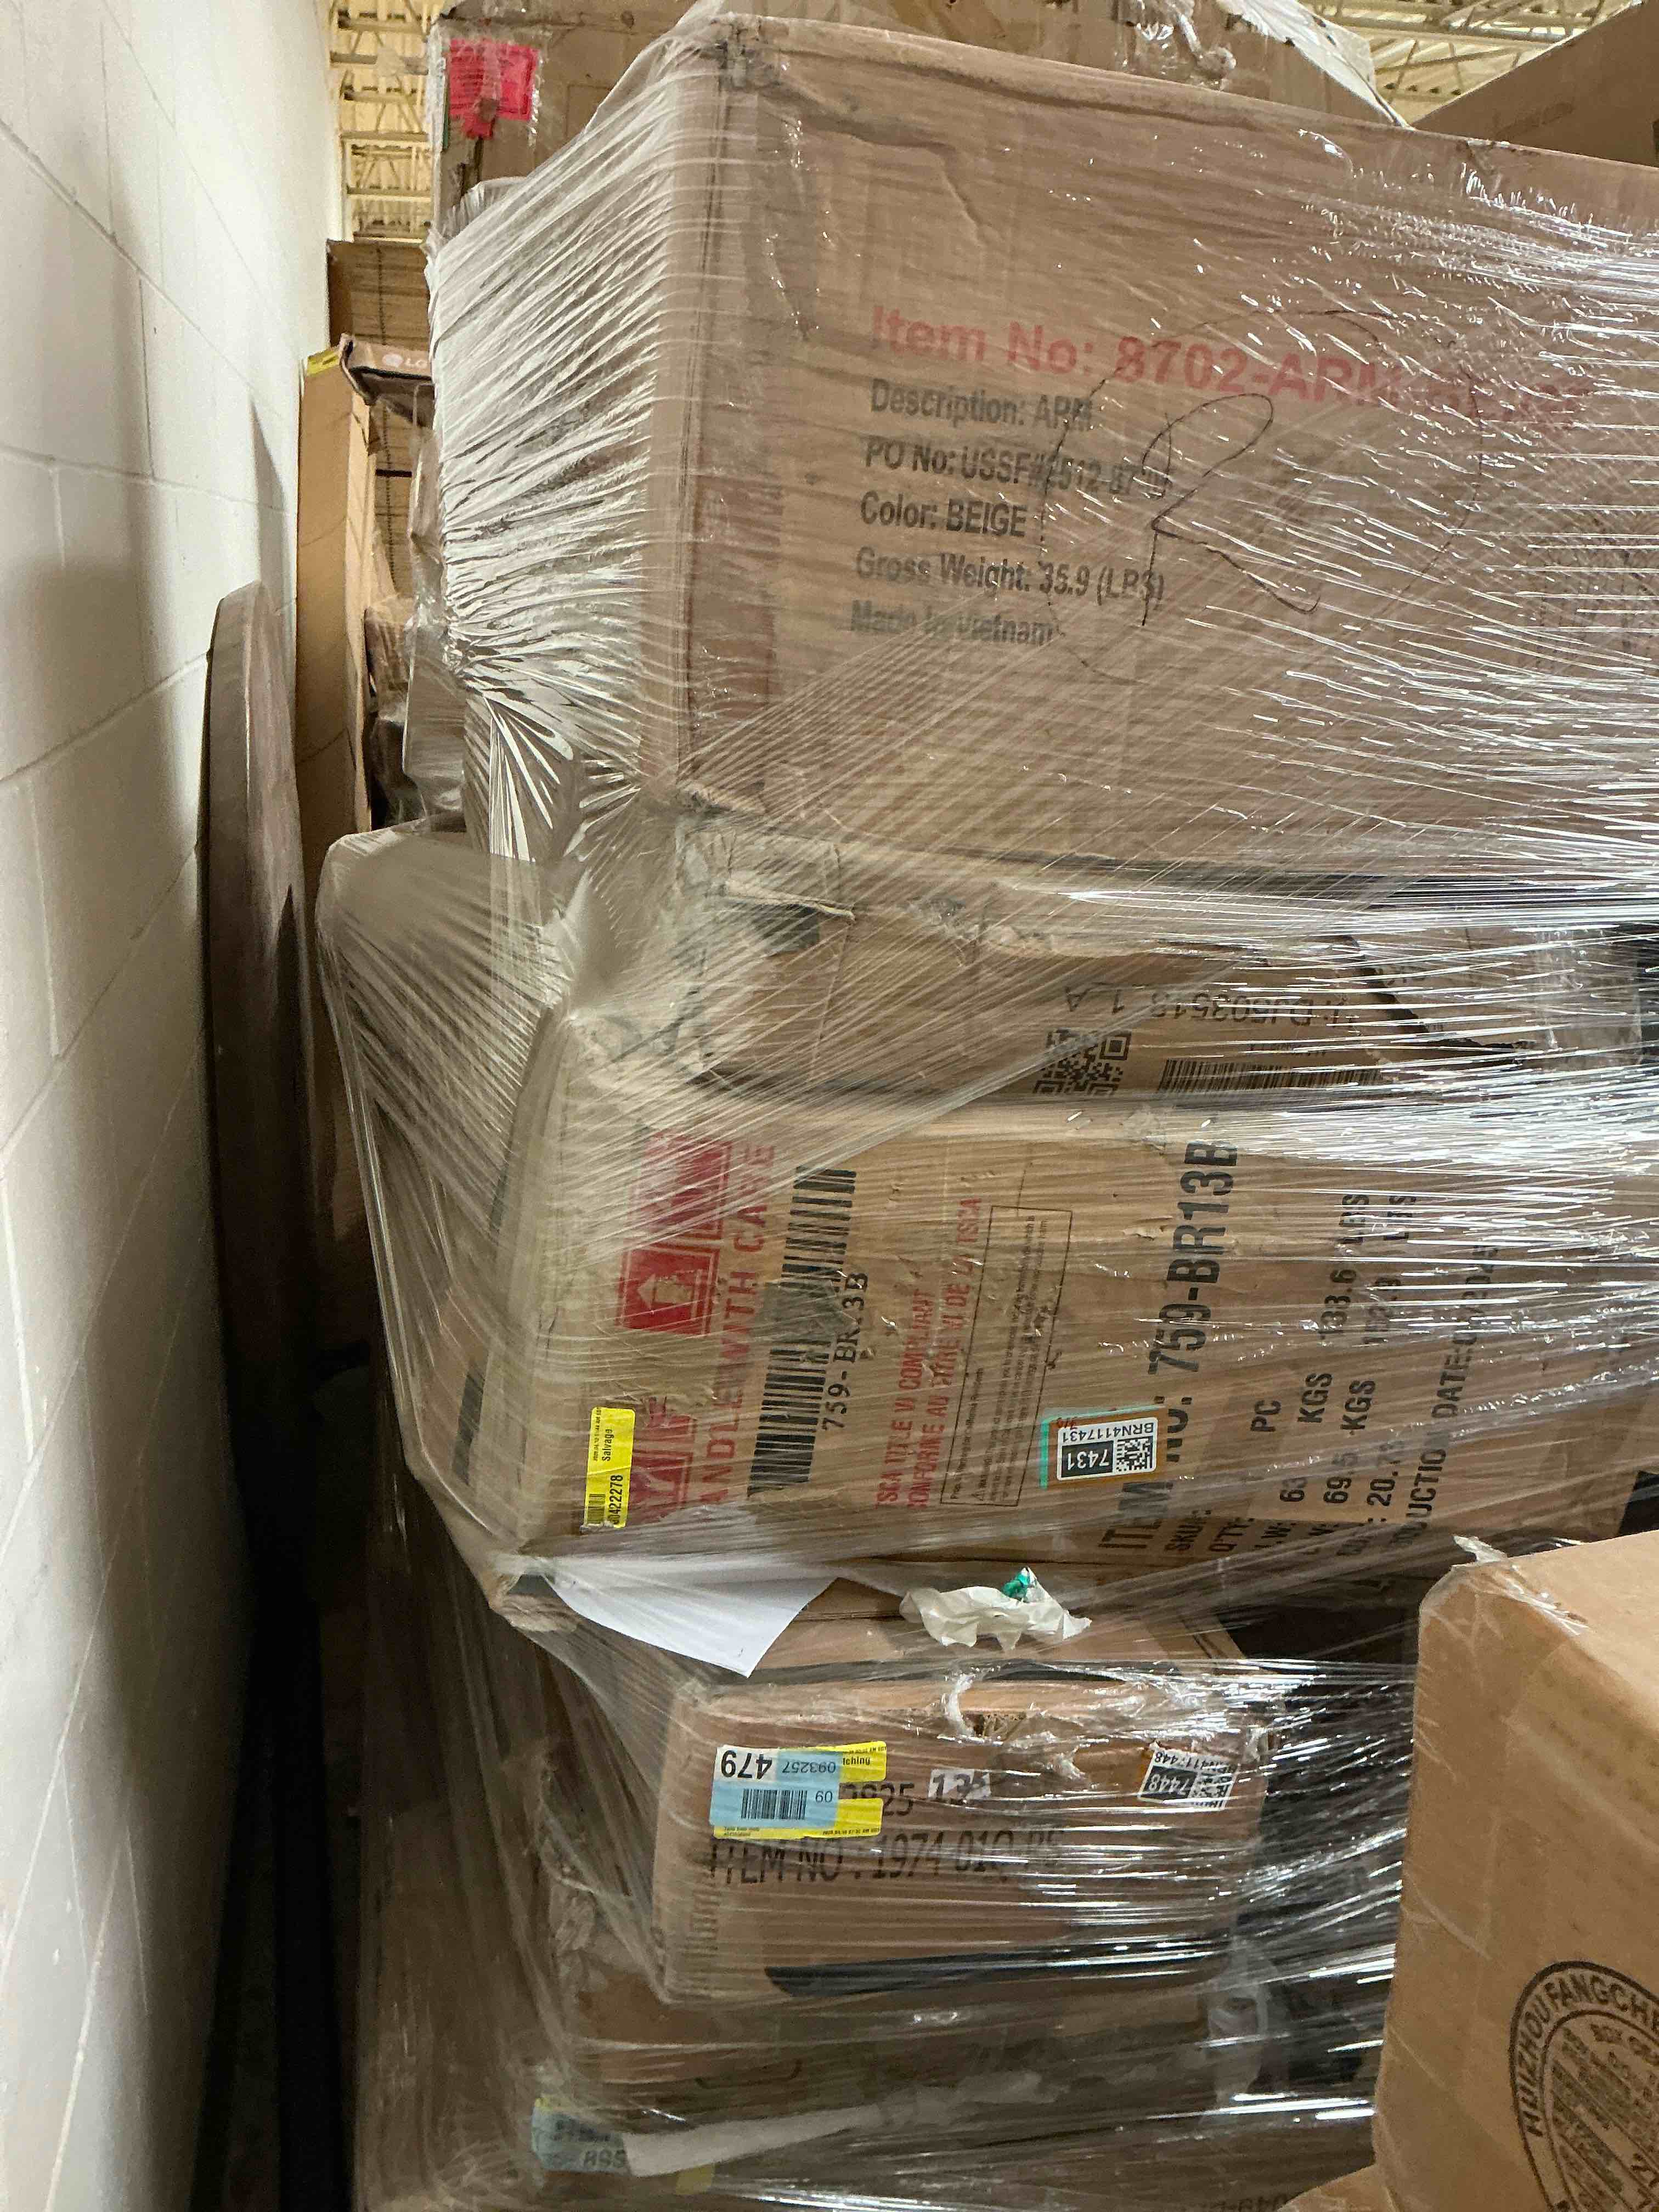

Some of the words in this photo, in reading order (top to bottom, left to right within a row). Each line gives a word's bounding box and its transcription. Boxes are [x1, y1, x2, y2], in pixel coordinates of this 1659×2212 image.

[872, 305, 986, 362] Item
[1008, 320, 1093, 375] No:
[871, 379, 1024, 427] Description:
[865, 435, 905, 470] PO
[861, 490, 937, 529] Color:
[946, 499, 1027, 537] BEIGE
[856, 547, 932, 582] Gross
[940, 552, 1030, 597] Weight:
[1039, 562, 1090, 595] 35.9
[956, 1198, 983, 1243] TSCA
[1148, 1140, 1238, 1375] 759-BR13B
[720, 1271, 757, 1359] WITH
[944, 1284, 970, 1308] DE
[821, 1272, 868, 1431] 759-BR3B
[926, 1395, 949, 1418] AU
[1250, 1400, 1282, 1432] PC
[1297, 1373, 1334, 1423] KGS
[1340, 1380, 1376, 1431] KGS
[601, 1429, 614, 1462] Salvage
[698, 1387, 743, 1503] ANDLE
[1063, 1423, 1154, 1442] BRN4117431
[1067, 1449, 1110, 1470] 7431
[720, 1750, 772, 1780] 479
[782, 1761, 836, 1774] 093257
[1149, 1774, 1190, 1796] 7448
[815, 1791, 833, 1803] 09
[711, 1842, 783, 1884] ITEM
